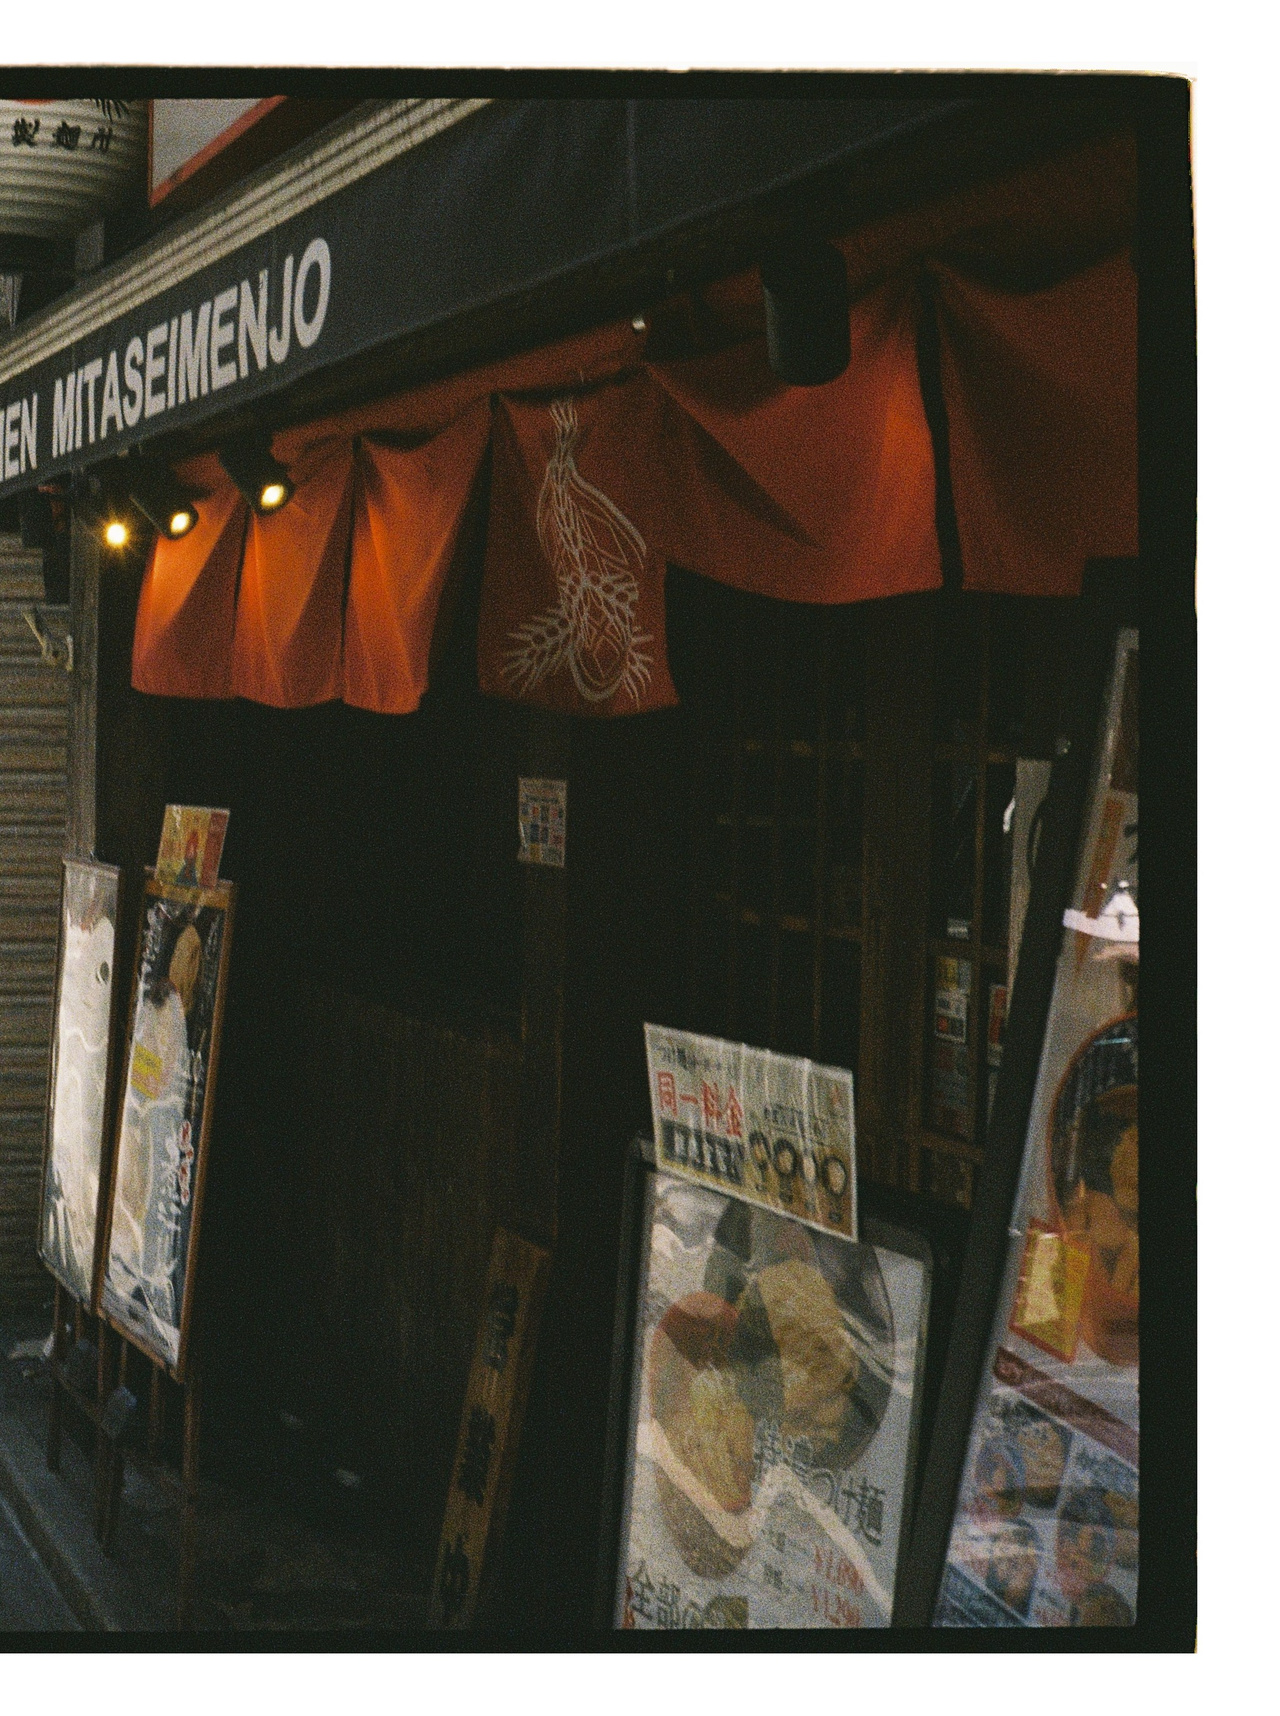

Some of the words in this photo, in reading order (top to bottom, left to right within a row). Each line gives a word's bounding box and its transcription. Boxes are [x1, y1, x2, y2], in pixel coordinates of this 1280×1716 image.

[51, 237, 332, 459] MITASEIMENJO
[656, 1070, 745, 1138] 同一料金
